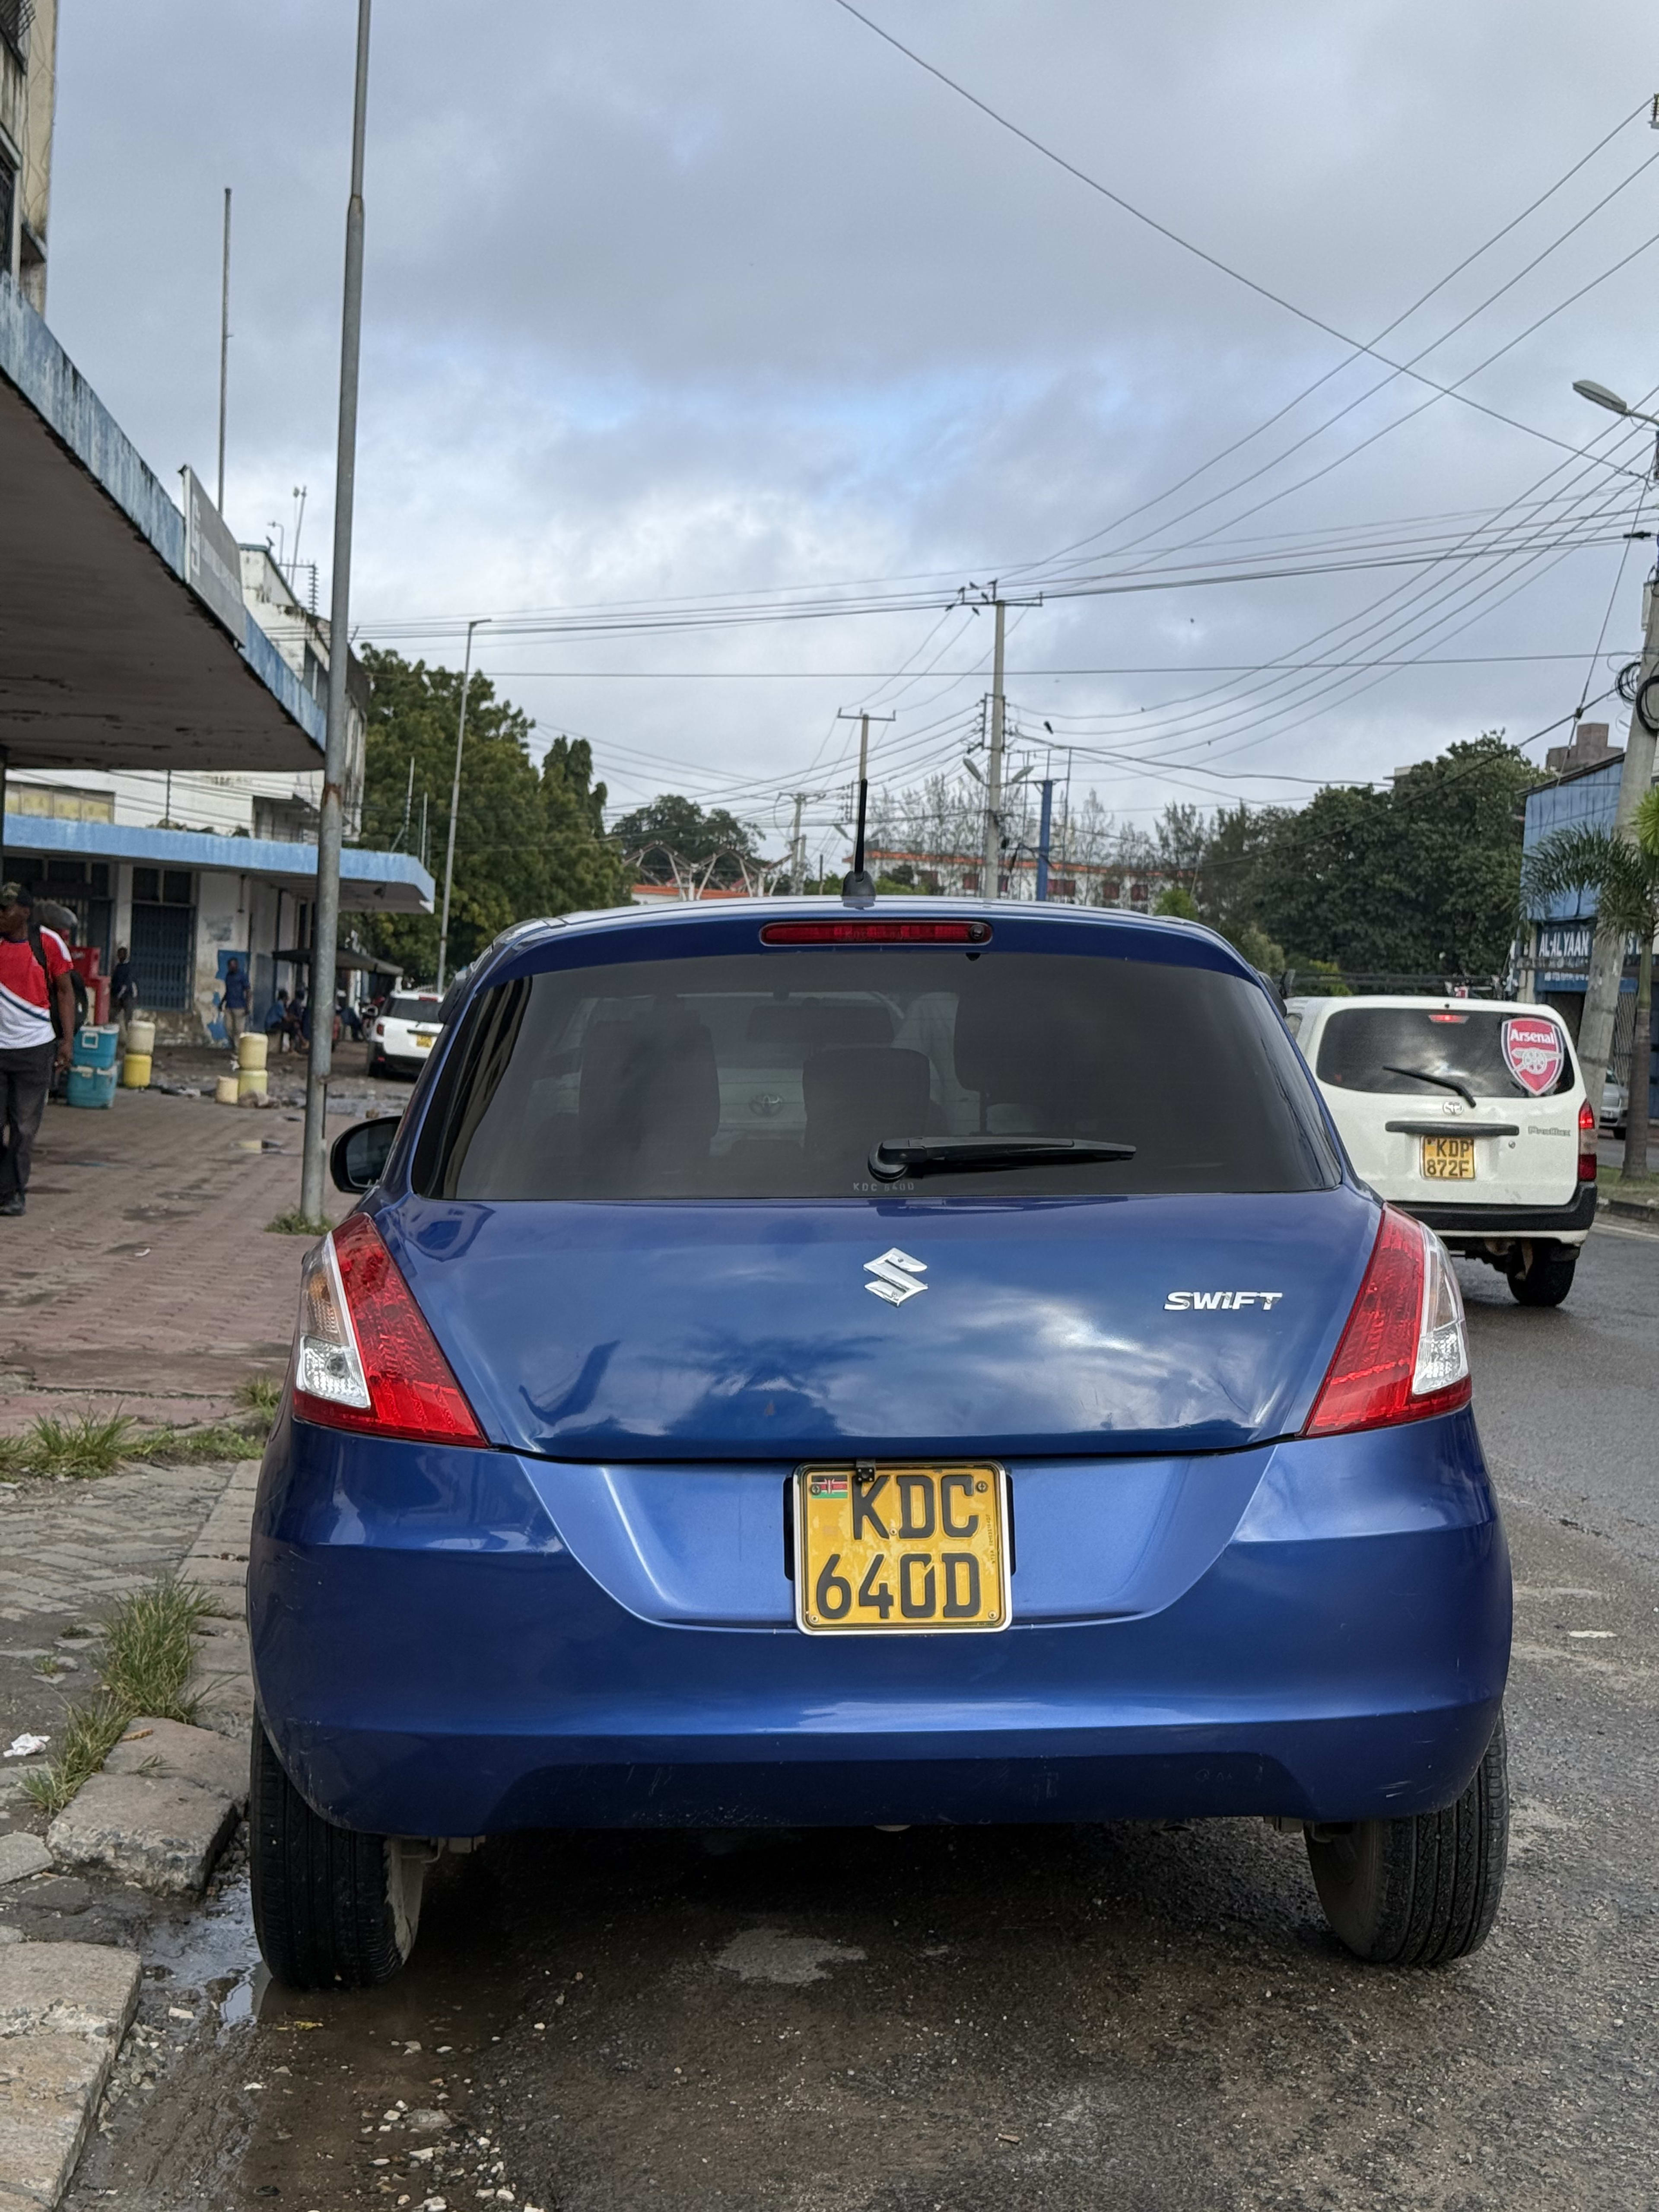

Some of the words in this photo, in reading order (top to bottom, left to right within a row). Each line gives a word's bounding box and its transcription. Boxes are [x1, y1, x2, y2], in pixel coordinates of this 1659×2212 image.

[1510, 1028, 1555, 1045] Arsenal
[1437, 1138, 1469, 1157] KDP
[1427, 1159, 1469, 1176] 872F
[853, 1182, 877, 1192] KDC
[1164, 1291, 1283, 1311] SWIFT
[852, 1474, 979, 1540] KDC
[817, 1553, 981, 1619] 640D
